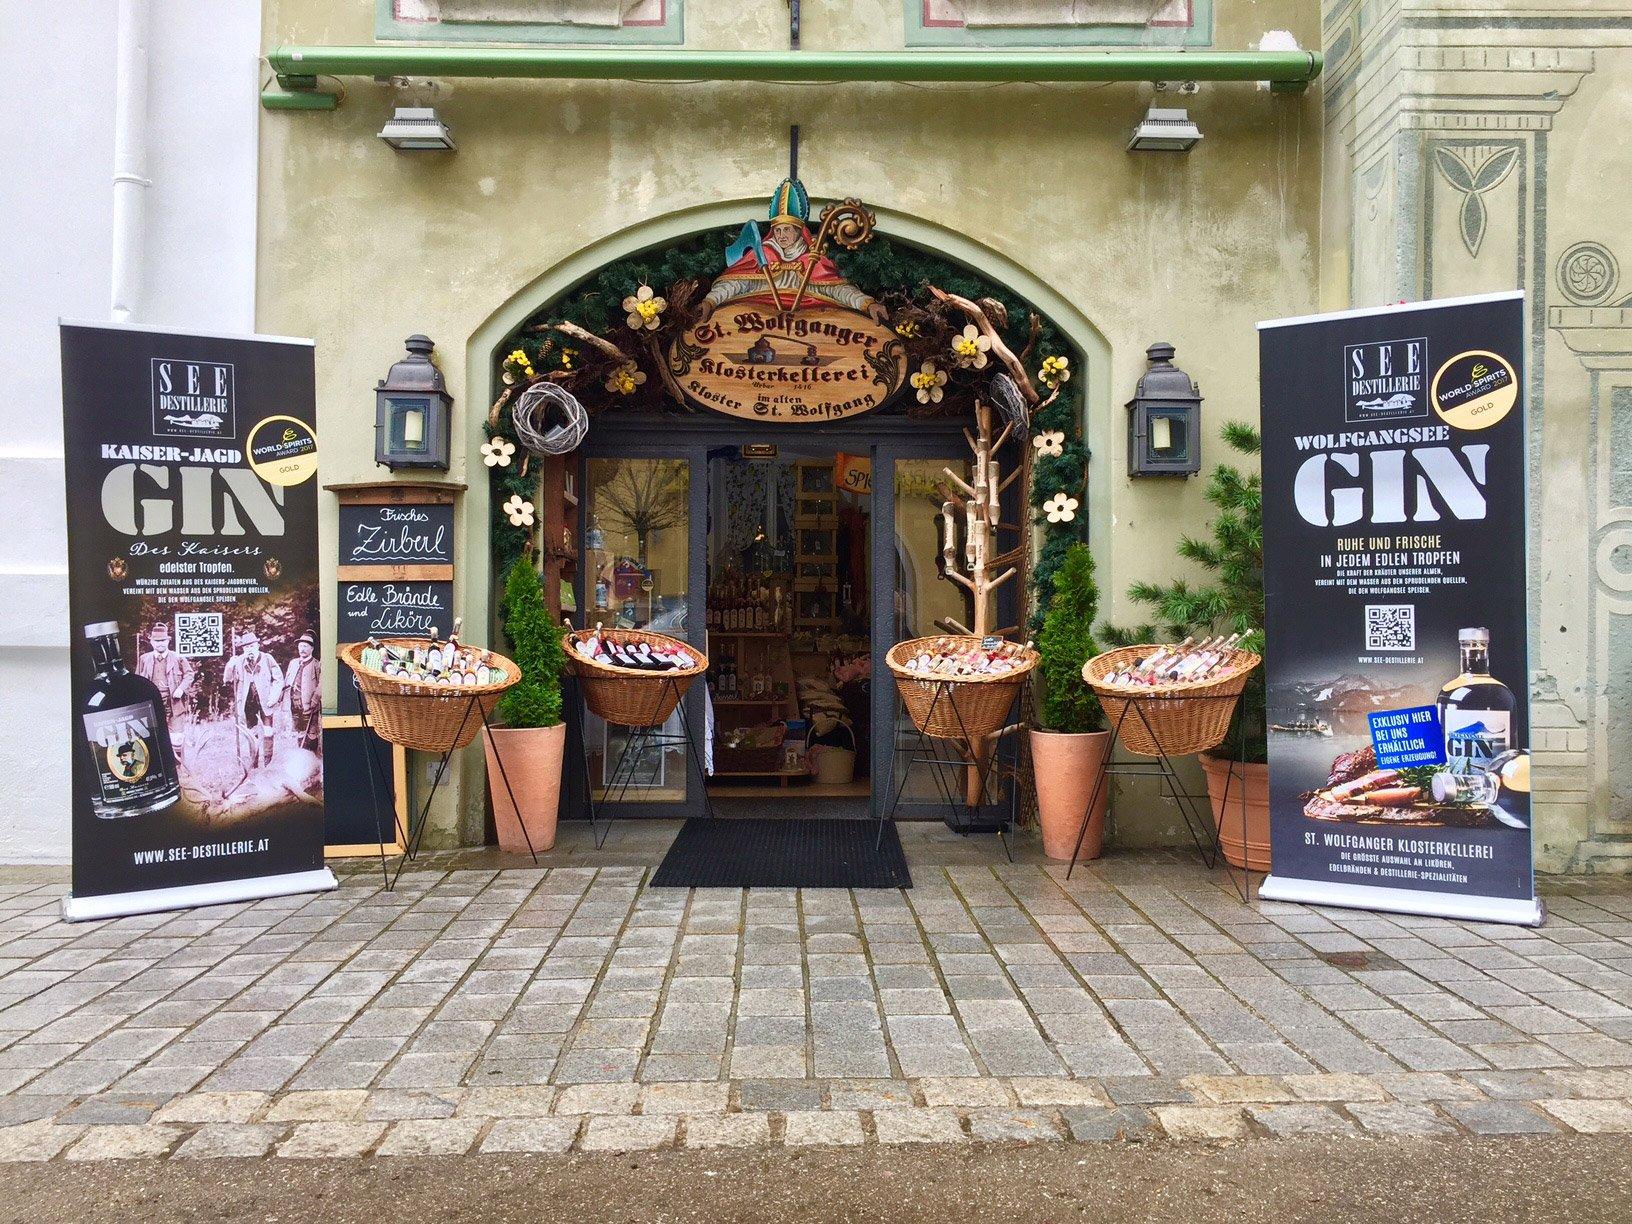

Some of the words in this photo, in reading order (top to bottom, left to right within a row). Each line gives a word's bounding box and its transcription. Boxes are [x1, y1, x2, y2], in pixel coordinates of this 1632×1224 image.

[695, 321, 731, 344] St.
[734, 312, 878, 348] Wolfganger
[699, 358, 869, 383] Klosterkellerei
[1352, 374, 1421, 396] DESTILLERIE
[1439, 384, 1472, 402] WORLD
[1473, 369, 1507, 388] SPIRITS
[1466, 383, 1492, 399] AWARD
[1492, 376, 1508, 387] 2017
[160, 394, 228, 413] DESTILLERIE
[688, 380, 742, 410] Kloster
[757, 393, 770, 403] im
[772, 393, 802, 404] alten
[753, 402, 782, 416] St.
[791, 393, 876, 418] Wolfgang
[1471, 402, 1494, 416] GOLD
[253, 443, 282, 456] WORLD
[282, 437, 313, 449] SPIRITS
[1294, 425, 1450, 451] WOLFGANGSEE
[101, 444, 242, 464] KAISER-JAGD
[276, 447, 298, 457] AWARD
[299, 444, 314, 454] 2017
[279, 464, 300, 473] GOLD
[1294, 444, 1491, 527] GIN
[101, 463, 285, 536] GIN
[380, 508, 429, 522] Frisches
[129, 541, 171, 556] Des
[178, 541, 262, 556] Kaisers
[1337, 537, 1364, 551] RUHE
[1369, 536, 1391, 550] UND
[1396, 535, 1442, 549] FRISCHE
[159, 561, 197, 573] edelster
[199, 561, 235, 576] Tropfen.
[1320, 554, 1332, 567] IN
[1336, 553, 1371, 567] JEDEM
[1375, 552, 1408, 566] EDLEN
[1412, 551, 1460, 566] TROPFEN
[1346, 578, 1358, 586] DEM
[1404, 577, 1441, 585] SPRUDELNDEN
[1374, 568, 1397, 576] KRÄUTER
[1398, 568, 1423, 576] UNSERER
[346, 585, 378, 603] Edle
[381, 584, 440, 605] Brände
[348, 607, 368, 618] und
[371, 607, 433, 630] Liköre
[1372, 713, 1409, 729] EXKLUSIV
[1411, 710, 1432, 723] HIER
[1375, 729, 1389, 741] BEI
[1390, 727, 1408, 740] UNS
[1378, 738, 1425, 754] ERHÄLTLICH
[1447, 737, 1495, 759] GIN
[1380, 755, 1400, 765] EIGENE
[1401, 750, 1438, 763] ERZEUGUNG!
[134, 838, 270, 866] WWW.SEE-DESTILLERIE.AT
[1304, 832, 1320, 846] ST.
[1324, 833, 1394, 851] WOLFGANGER
[1398, 839, 1494, 860] KLOSTERKELLEREI
[1340, 852, 1351, 861] DIE
[1353, 852, 1380, 863] GRÖSSTE
[1381, 855, 1412, 866] AUSWAHL
[1413, 858, 1423, 867] AN
[1328, 863, 1372, 875] EDELBRÄNDEN
[1373, 867, 1379, 876] &
[1380, 868, 1468, 884] DESTILLERIE-SPEZIALITÄTEN
